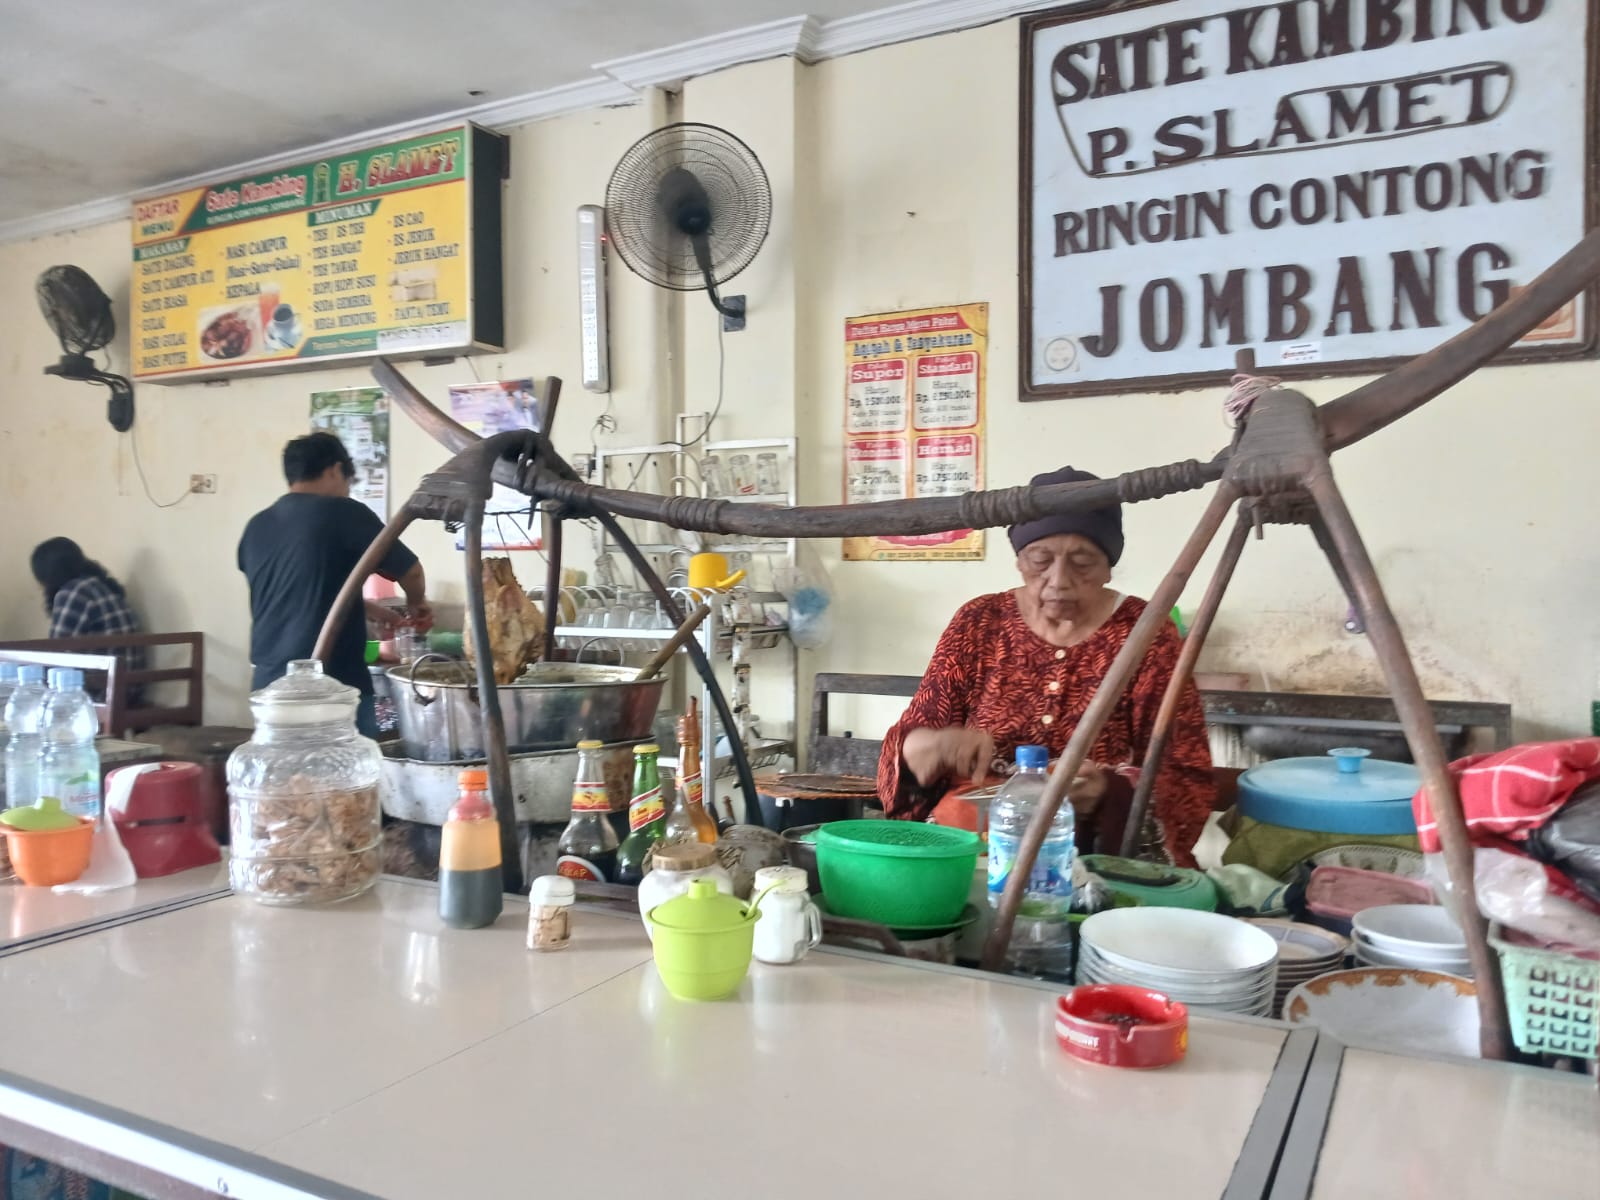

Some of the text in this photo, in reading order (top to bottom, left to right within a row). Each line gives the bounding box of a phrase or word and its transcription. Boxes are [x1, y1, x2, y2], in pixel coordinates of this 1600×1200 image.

[1054, 20, 1206, 105] SATE
[1087, 68, 1508, 175] P. SLAMET
[366, 138, 460, 189] SLAMET
[207, 175, 307, 213] Sate Kambing
[1053, 149, 1547, 258] RINGIN CONTONG
[138, 200, 180, 222] DAFTAR
[316, 203, 373, 224] MINUMAN
[407, 212, 425, 226] CAO
[143, 222, 175, 236] MENU
[314, 229, 329, 242] TEH
[350, 223, 365, 236] TEH
[408, 229, 436, 244] JERUK
[141, 238, 187, 259] MAKANAN
[227, 237, 288, 260] NASI CAMPUR
[314, 241, 362, 259] TEH HANGAT
[395, 244, 460, 265] JERUK HANGAT
[143, 255, 195, 276] SATE DAGING
[314, 260, 358, 277] TEH TAWAR
[143, 270, 214, 294] SATE CAMPUR ATI
[227, 283, 261, 299] KEPALA
[143, 299, 162, 313] SATE
[314, 301, 334, 313] SODA
[1079, 242, 1512, 358] JOMBANG
[854, 334, 973, 359] Aqiqah & Tasyakuran
[854, 369, 904, 382] Super
[919, 444, 971, 456] Hemat
